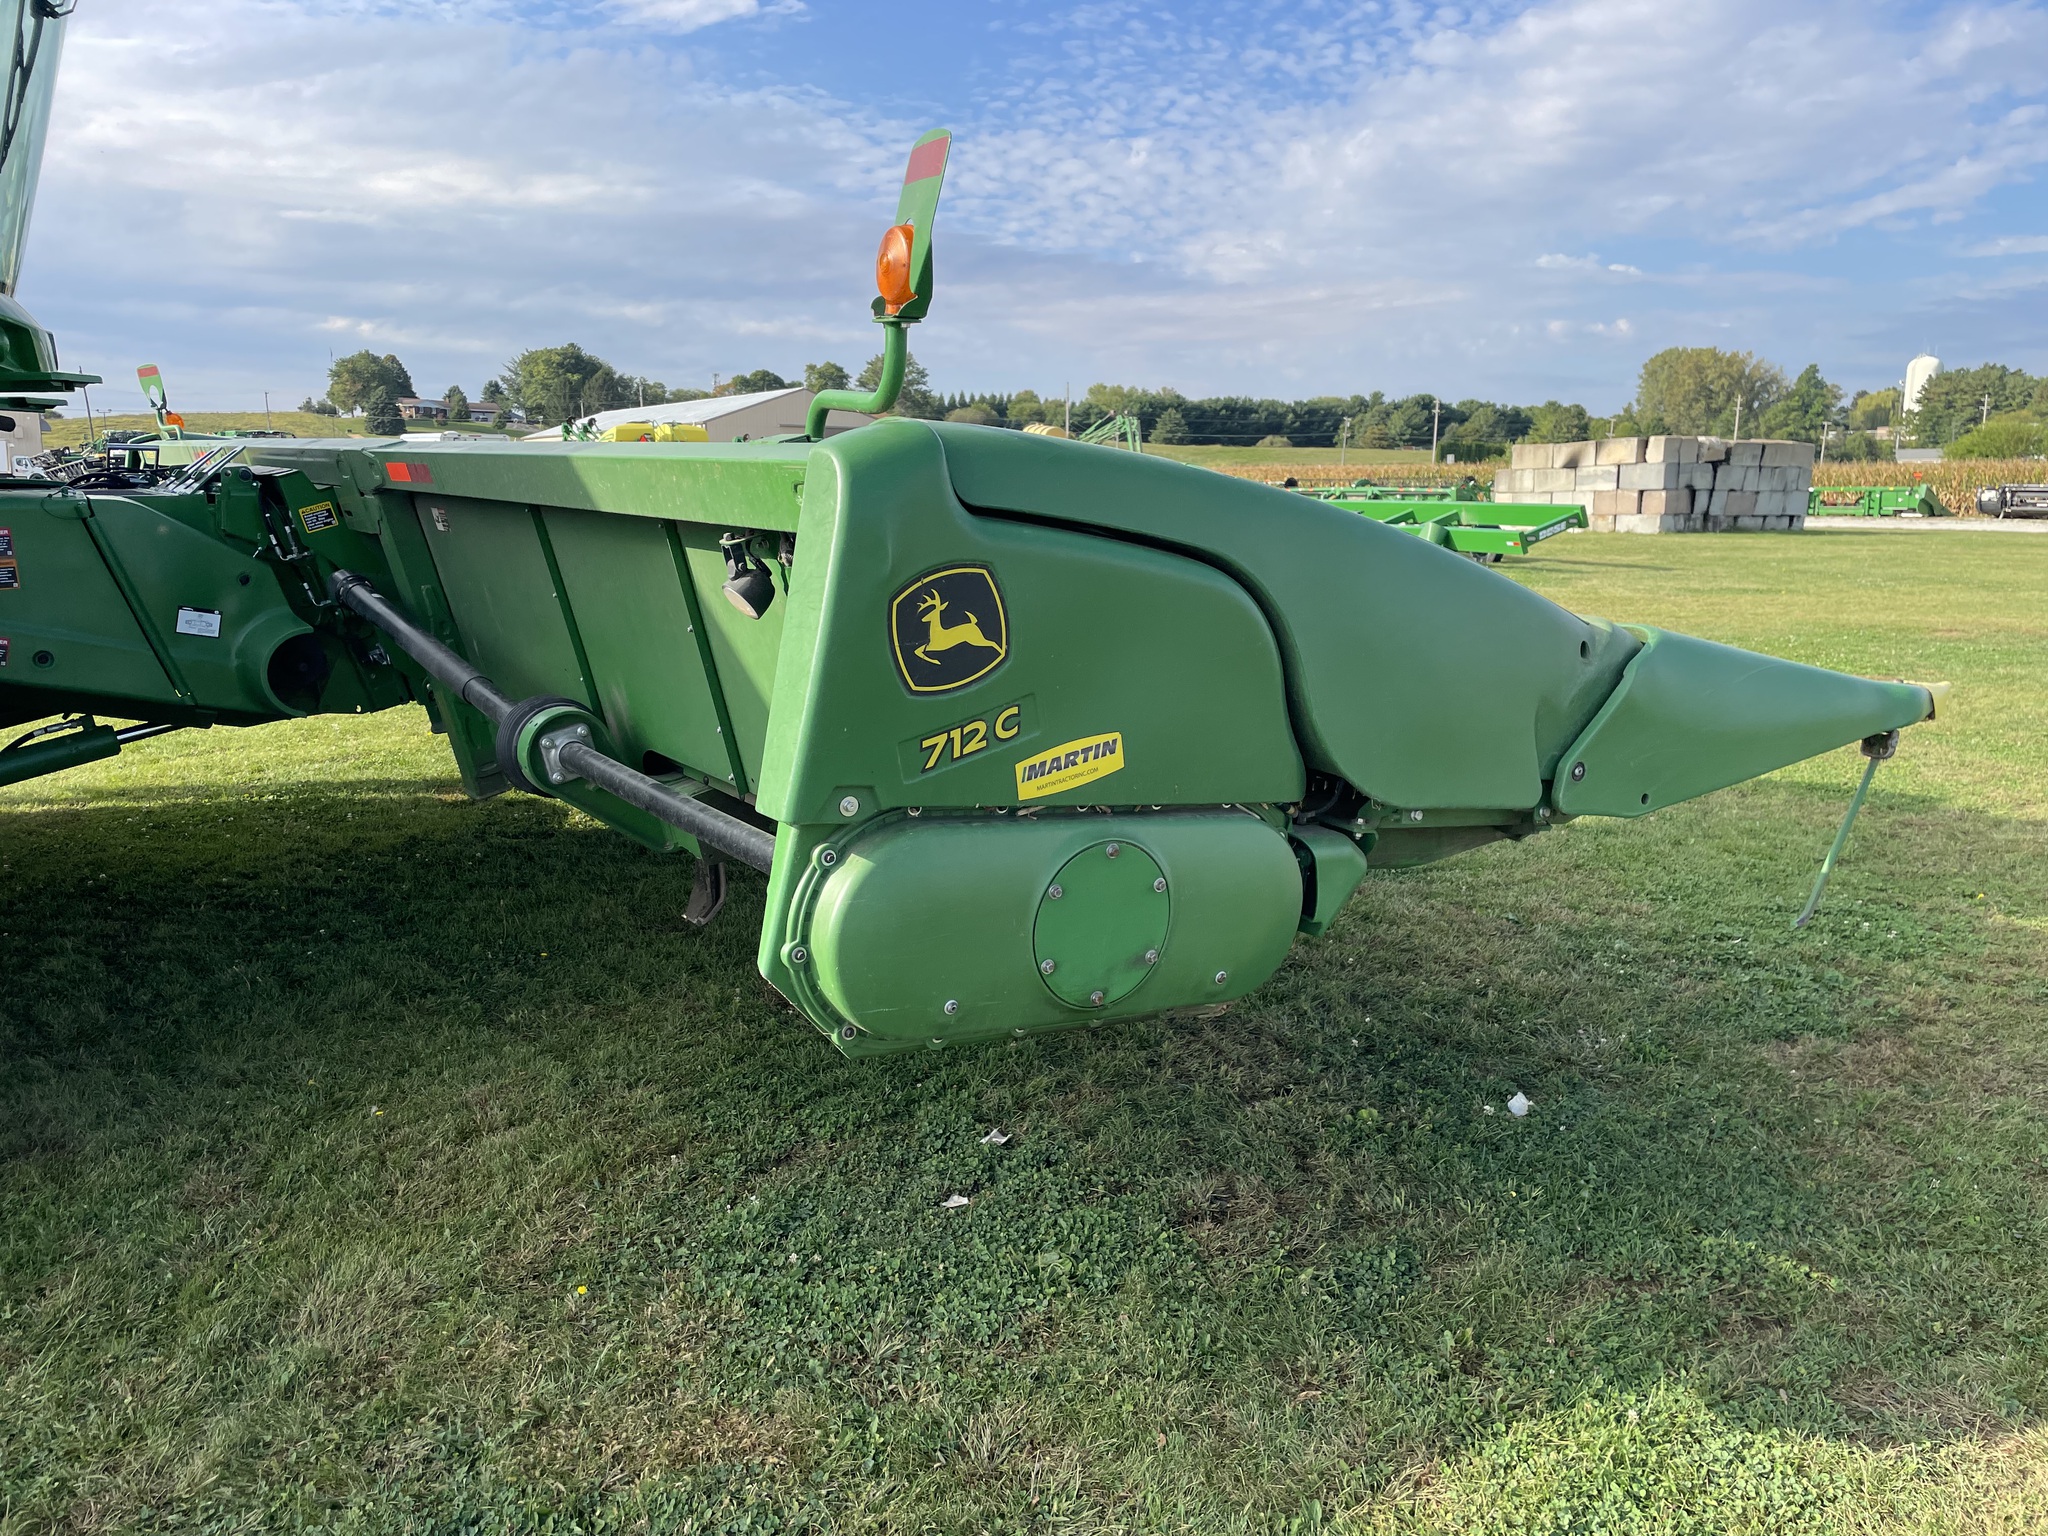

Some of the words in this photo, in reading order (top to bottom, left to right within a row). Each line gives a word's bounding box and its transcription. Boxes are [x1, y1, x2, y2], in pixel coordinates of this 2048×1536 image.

[305, 503, 330, 513] CAUTION
[921, 719, 987, 772] 712
[993, 704, 1020, 741] C
[1026, 738, 1118, 781] MARTIN
[1036, 766, 1099, 791] MARTINTRACTORINC.COM
